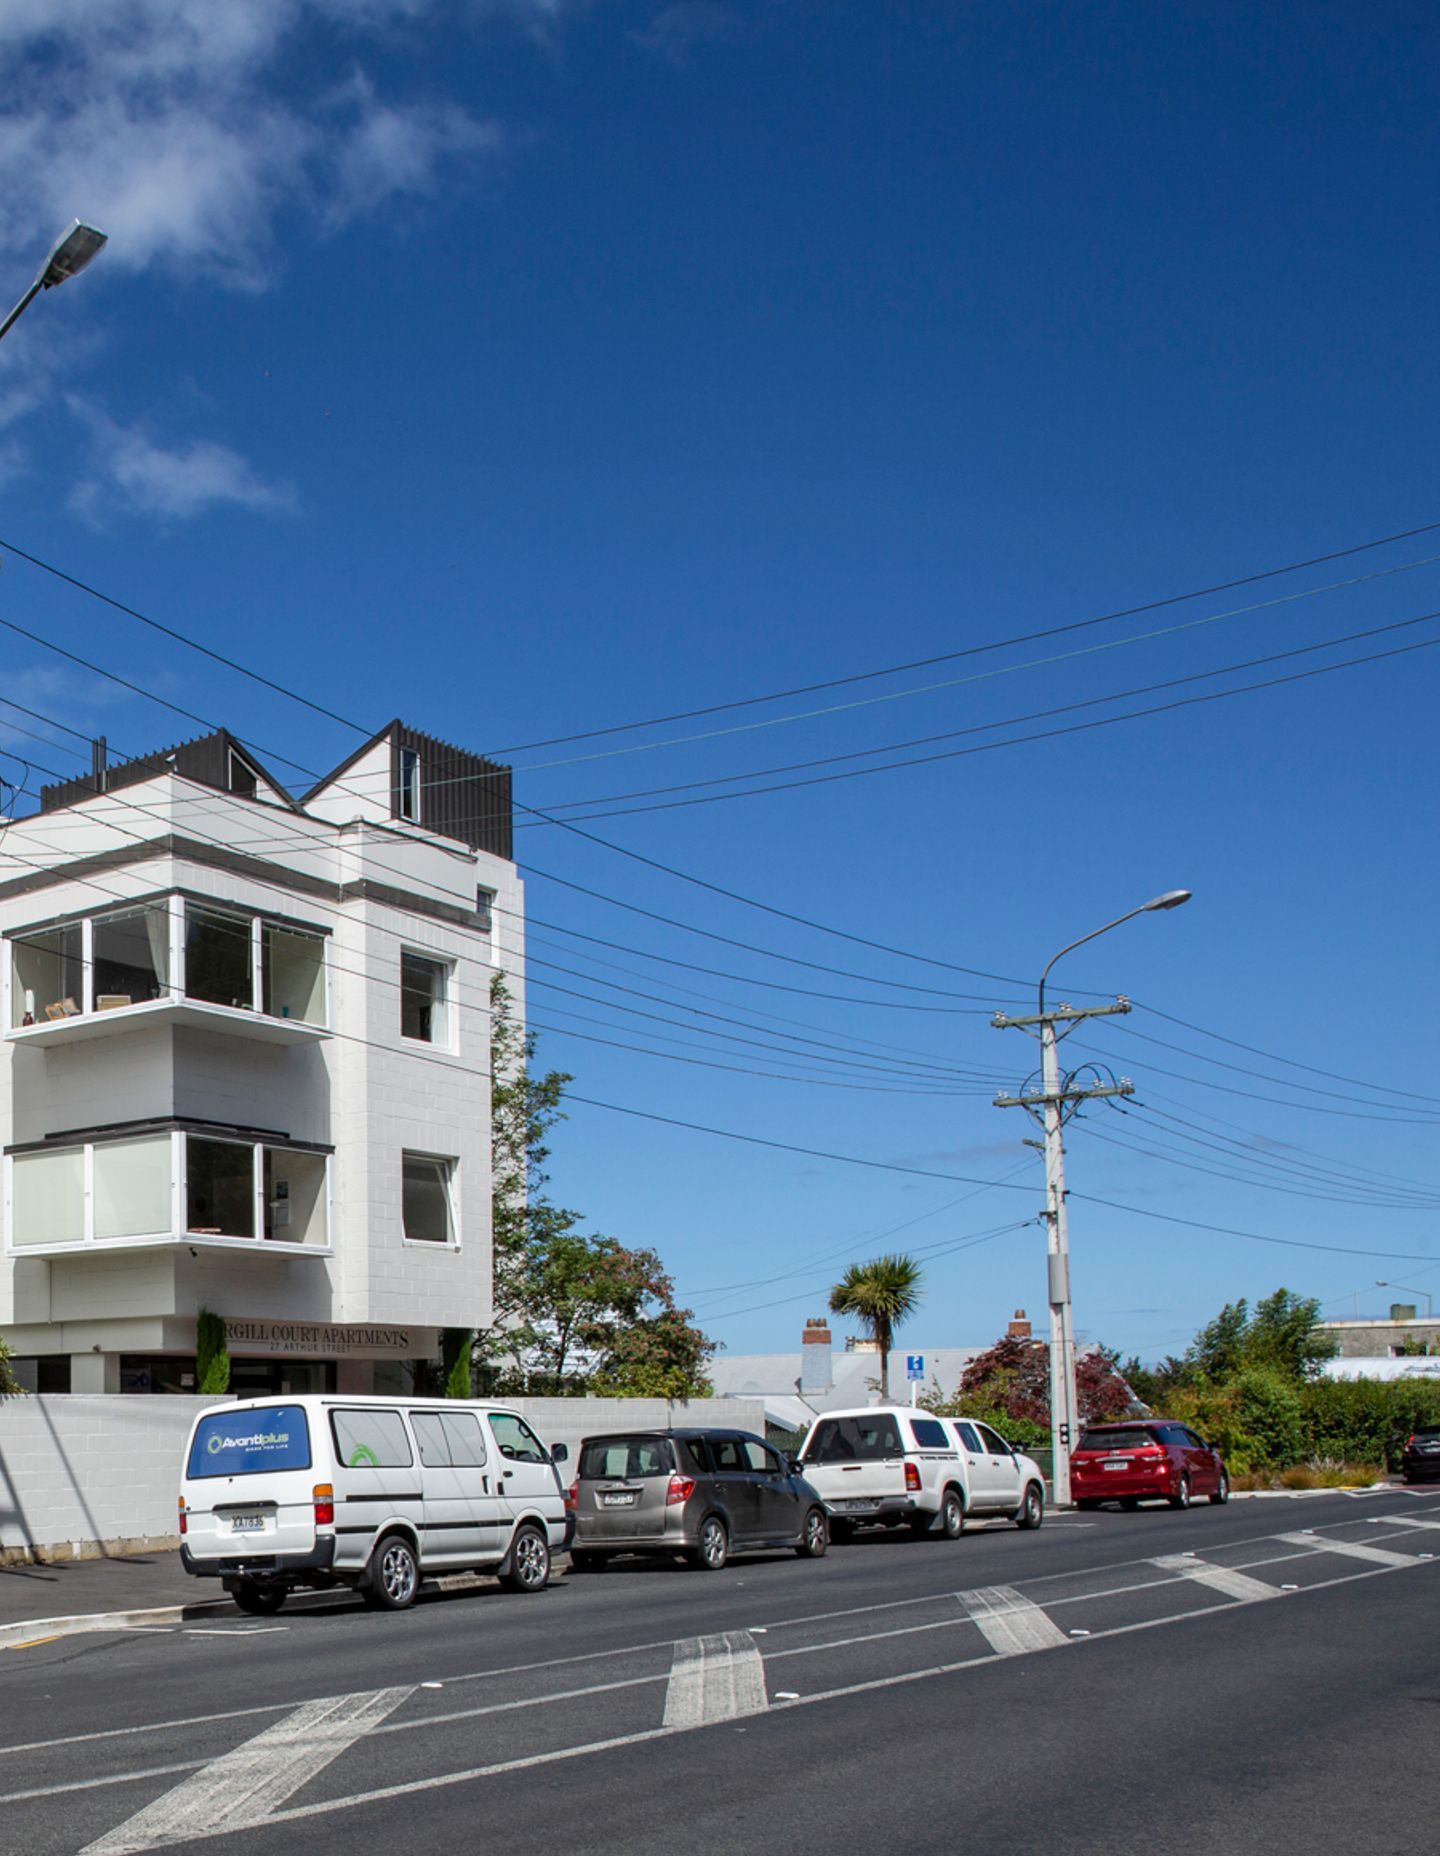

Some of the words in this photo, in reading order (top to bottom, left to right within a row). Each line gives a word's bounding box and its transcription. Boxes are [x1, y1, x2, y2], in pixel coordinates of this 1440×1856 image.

[224, 1322, 269, 1340] RGILL
[271, 1324, 320, 1342] COURT
[322, 1327, 409, 1349] APARTMENTS
[283, 1342, 319, 1352] ARTHUR
[322, 1343, 351, 1353] STREET
[222, 1433, 289, 1448] Avantiplus
